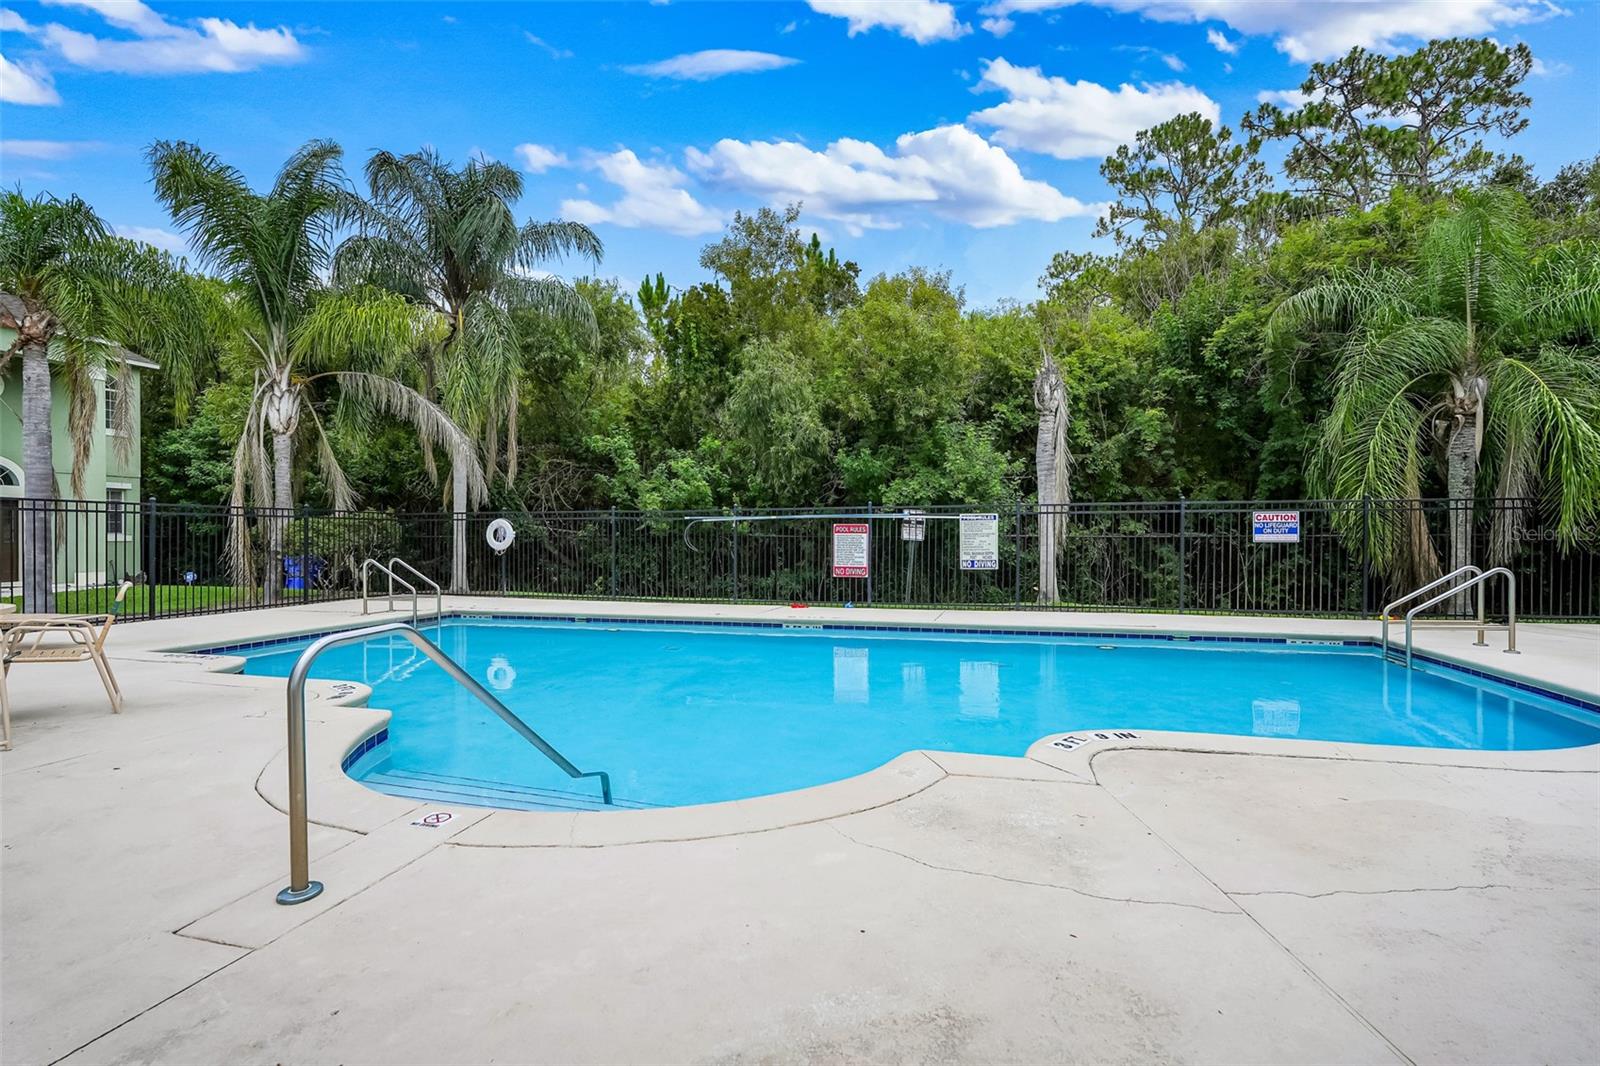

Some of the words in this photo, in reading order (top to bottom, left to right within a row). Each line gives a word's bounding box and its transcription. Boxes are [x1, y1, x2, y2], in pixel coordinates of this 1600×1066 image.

[962, 560, 972, 568] NO
[974, 560, 996, 568] DIVING
[845, 567, 866, 576] DIVING
